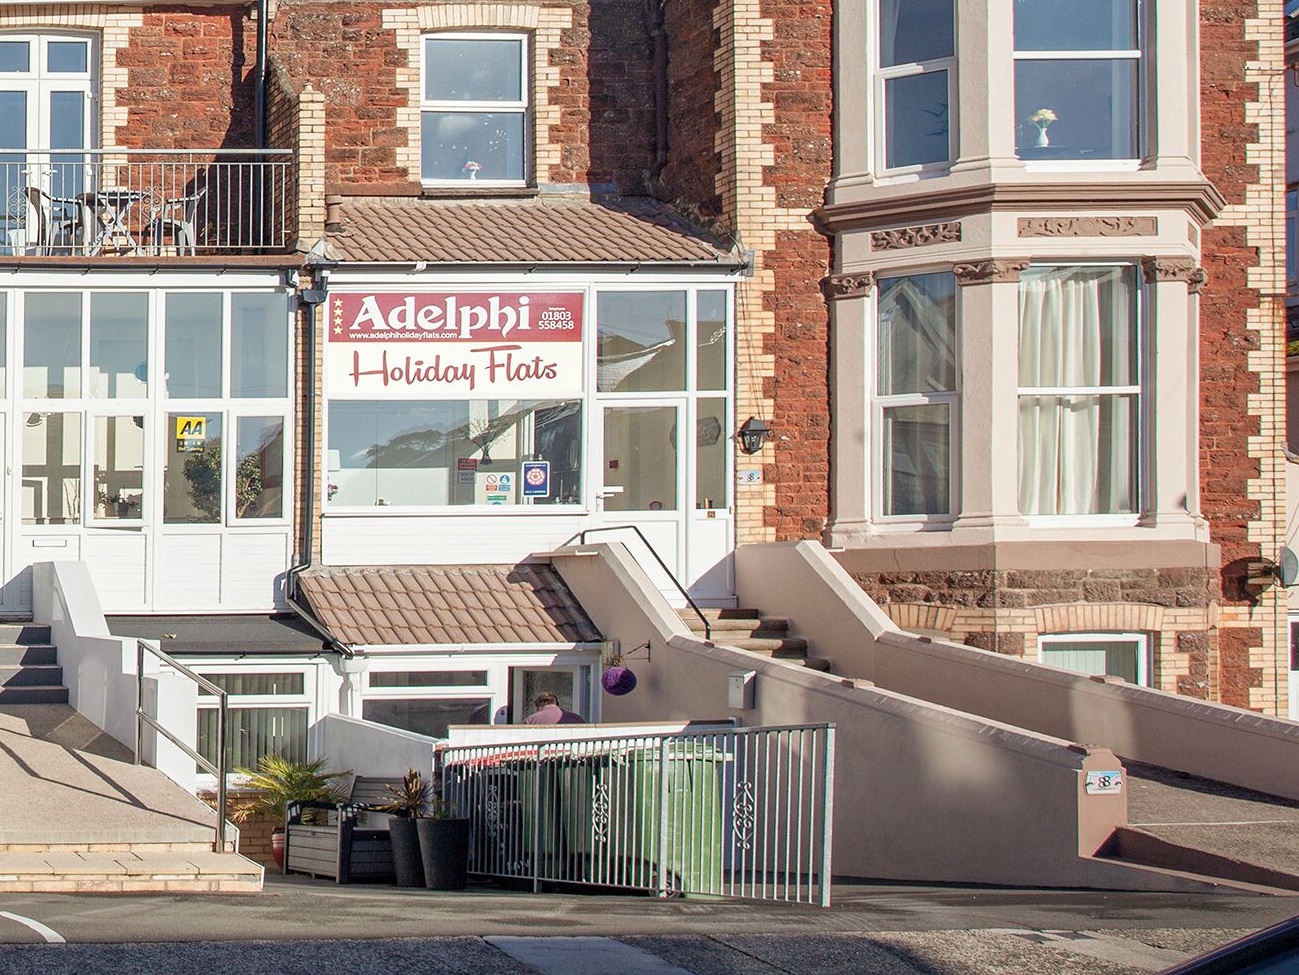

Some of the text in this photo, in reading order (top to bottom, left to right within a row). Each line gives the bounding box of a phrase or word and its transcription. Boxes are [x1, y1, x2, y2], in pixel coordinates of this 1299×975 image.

[350, 295, 532, 339] Adelphi
[541, 311, 572, 321] 01803
[538, 320, 575, 330] 558458
[348, 331, 458, 340] www.adelphiholidayflats.com
[349, 344, 558, 391] Holiday Flats
[179, 420, 203, 436] AA
[1098, 775, 1111, 788] 8
